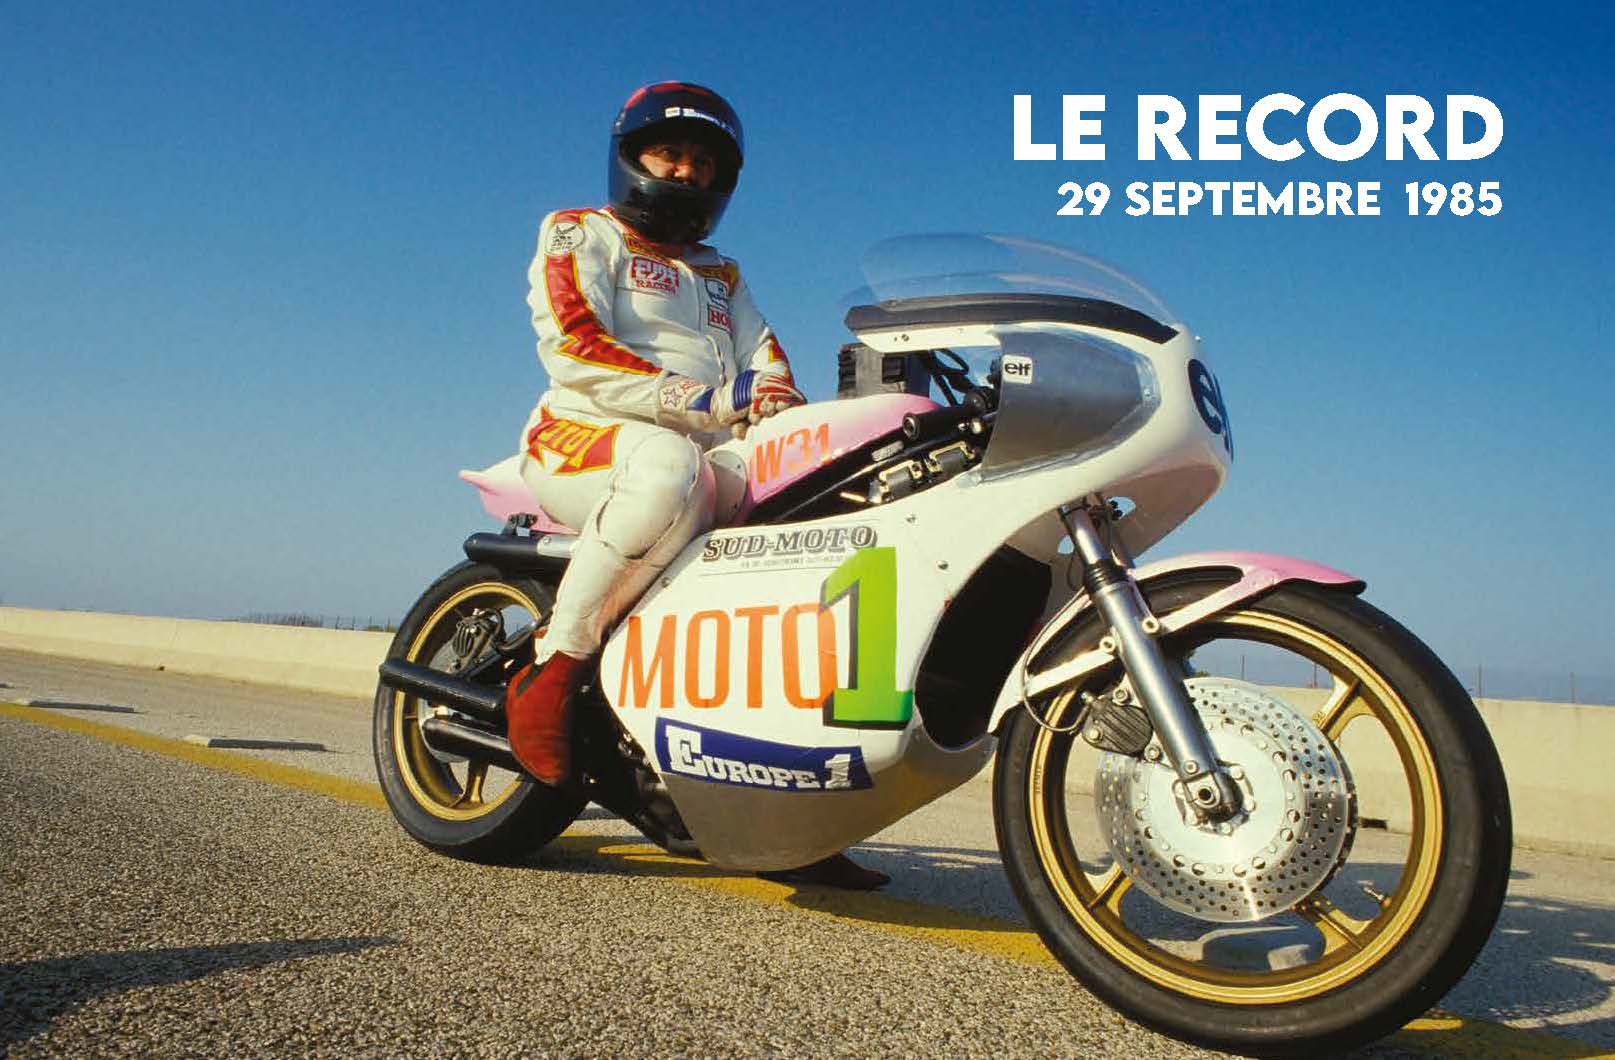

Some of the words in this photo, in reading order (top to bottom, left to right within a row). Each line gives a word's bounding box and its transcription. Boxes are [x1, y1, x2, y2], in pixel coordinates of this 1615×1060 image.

[1004, 362, 1032, 376] elf
[748, 422, 831, 485] W31
[703, 525, 878, 563] SUD-MOTO
[617, 602, 839, 709] MOTO
[819, 546, 914, 731] 1
[665, 724, 821, 789] EUROPE
[824, 753, 852, 789] 1
